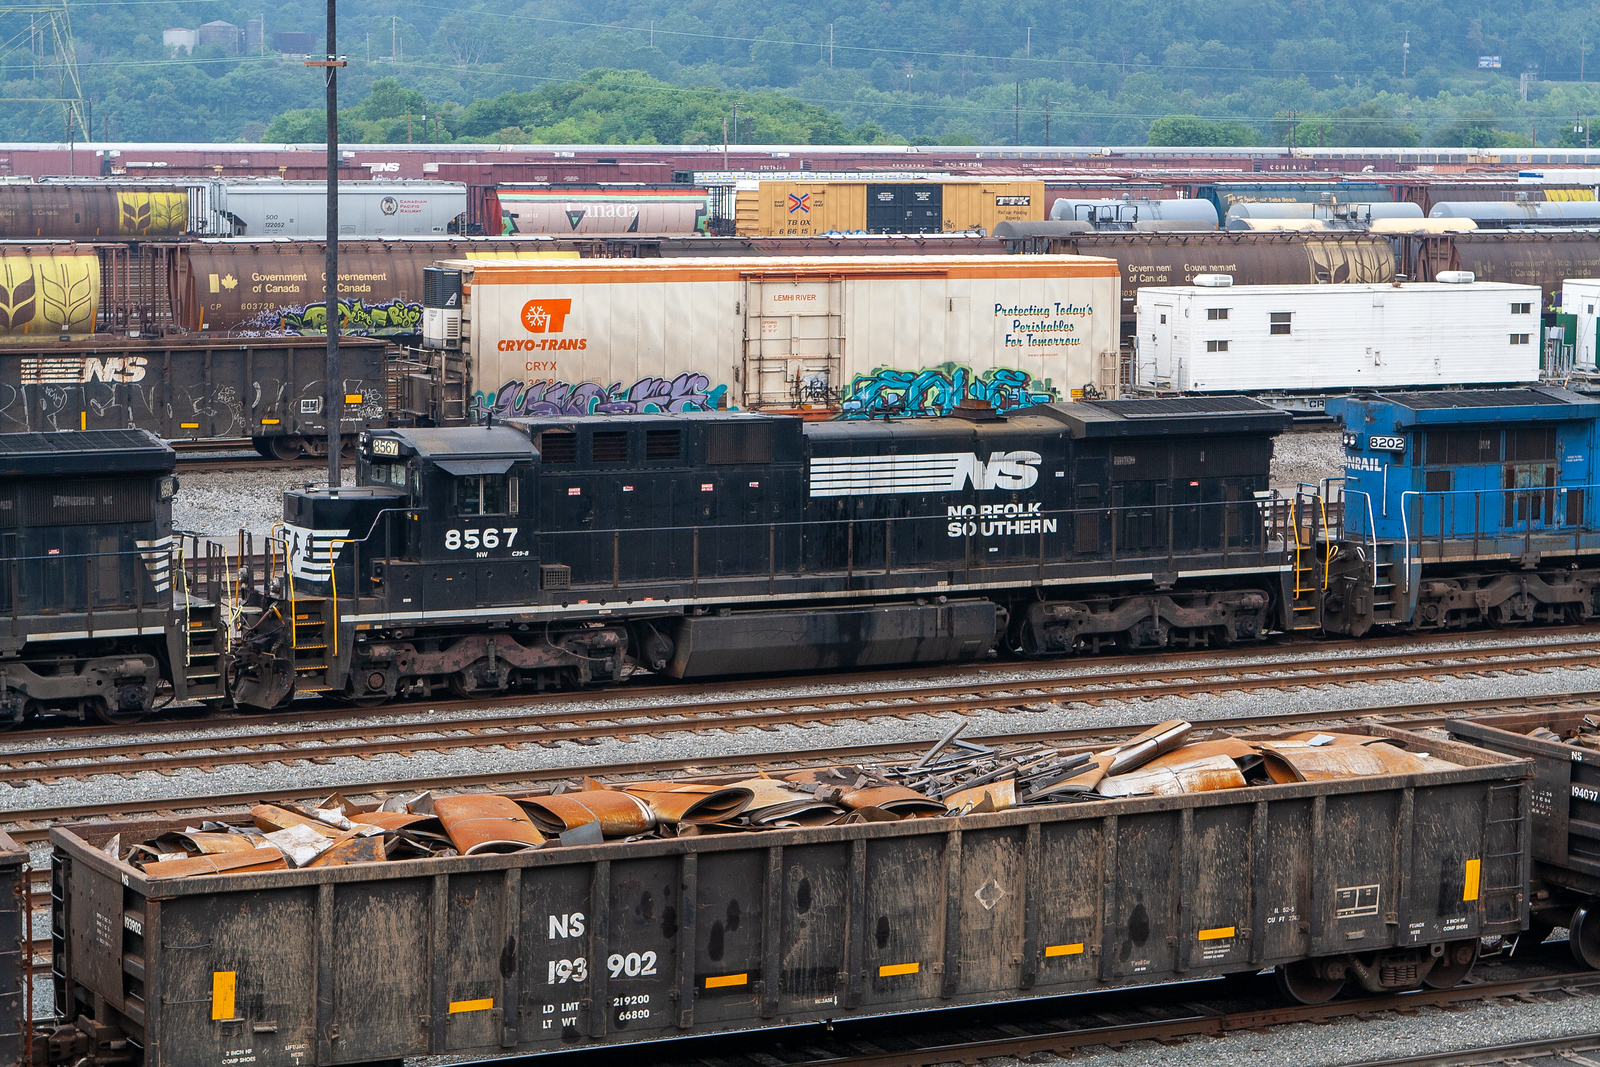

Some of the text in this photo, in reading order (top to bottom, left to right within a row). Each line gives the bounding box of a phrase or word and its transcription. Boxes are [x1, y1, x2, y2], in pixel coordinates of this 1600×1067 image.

[379, 162, 400, 172] NS
[996, 196, 1030, 206] TTX
[565, 199, 640, 219] Canada
[1183, 263, 1237, 272] Gouvenement
[251, 272, 388, 282] Government Guvernement
[1128, 273, 1137, 283] of
[1139, 273, 1168, 283] Canda
[252, 283, 300, 293] of Canada
[337, 283, 371, 292] Canada
[773, 294, 795, 302] LEMHI
[210, 302, 275, 311] CP 603728
[994, 302, 1094, 319] Protecting Today's
[1012, 319, 1075, 333] Perishables
[497, 338, 588, 352] CRYO-TRANS
[1004, 333, 1024, 347] For
[84, 356, 149, 383] NS
[525, 361, 558, 371] CRYX
[1309, 400, 1326, 408] CR
[373, 439, 397, 454] 8567
[1369, 437, 1405, 449] 8202
[953, 450, 1043, 491] NS
[1345, 456, 1383, 472] NRAIL
[946, 502, 1043, 520] NORFOLK
[946, 518, 1058, 538] SOUTHERN
[444, 527, 519, 551] 8567
[476, 551, 489, 559] NW
[1571, 751, 1583, 761] NS
[124, 915, 142, 936] 193902
[548, 912, 586, 940] NS
[547, 950, 658, 985] 193 902
[542, 994, 650, 1014] LD LMT 219200
[542, 1009, 650, 1029] LT WT 66800
